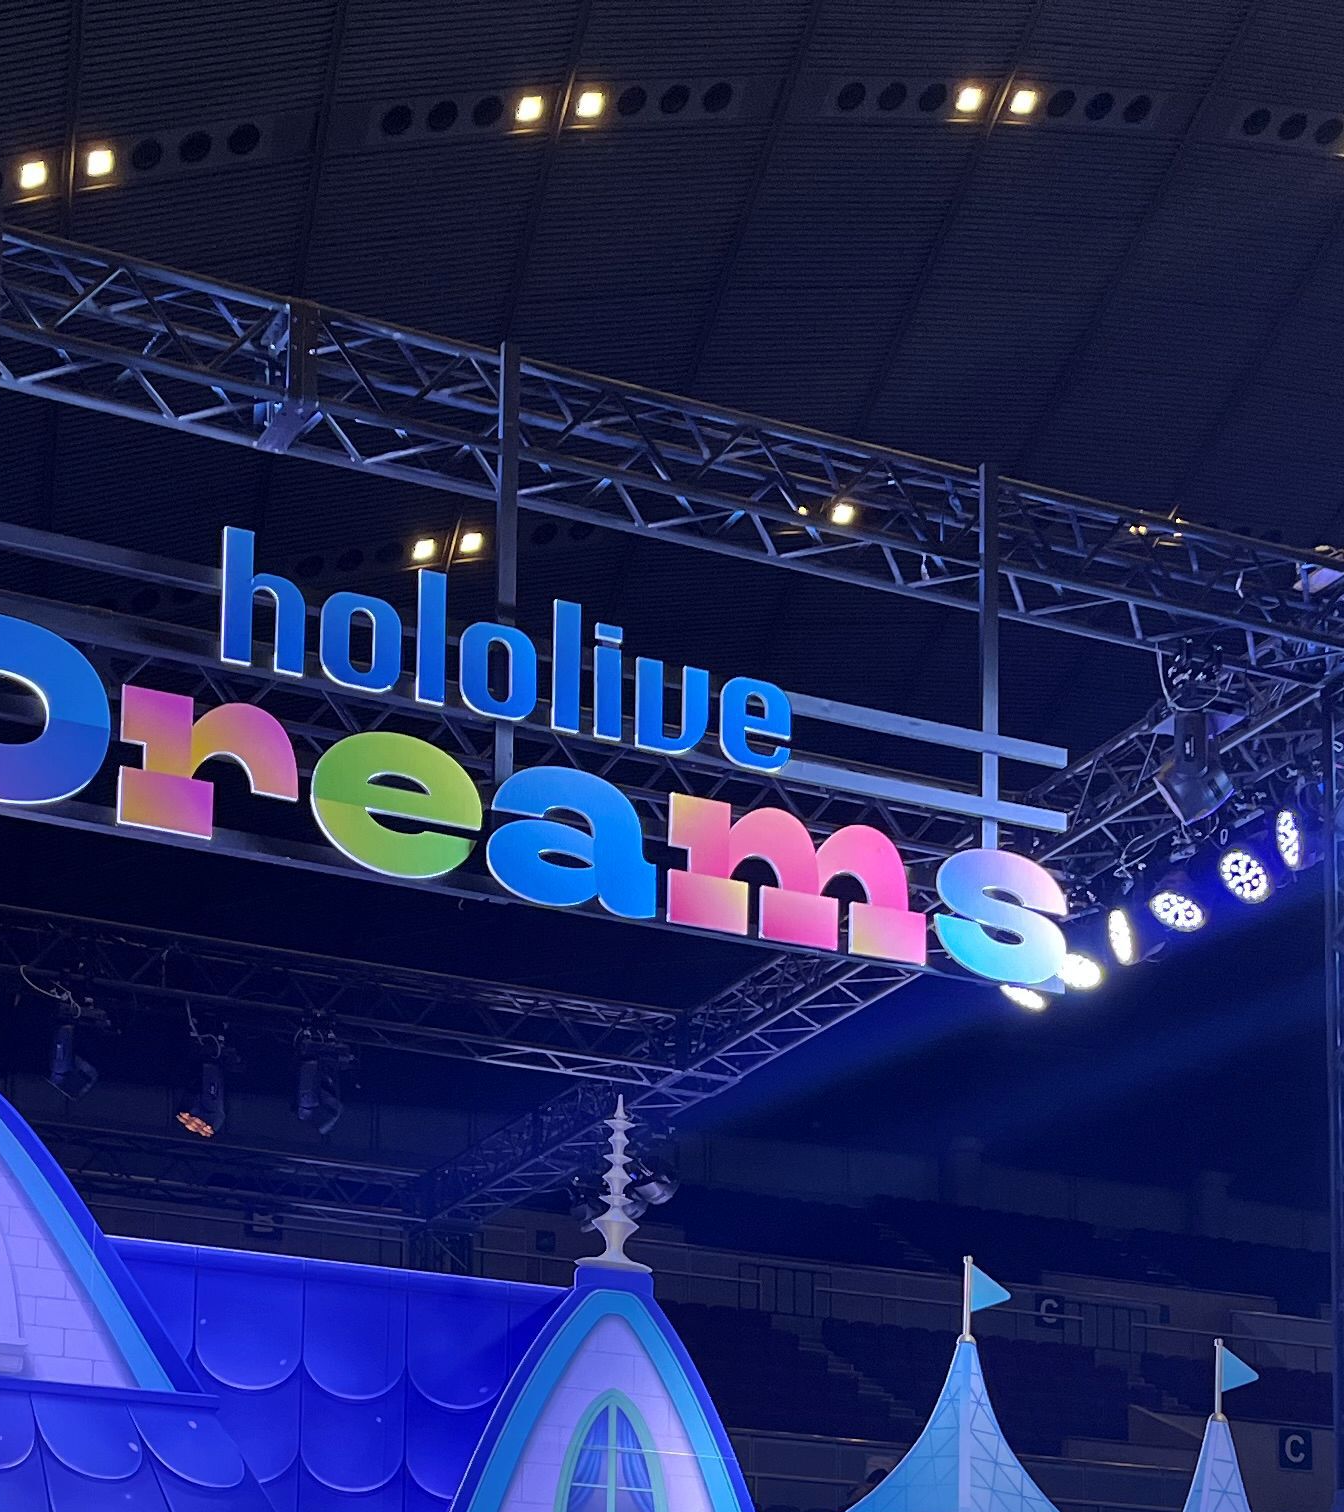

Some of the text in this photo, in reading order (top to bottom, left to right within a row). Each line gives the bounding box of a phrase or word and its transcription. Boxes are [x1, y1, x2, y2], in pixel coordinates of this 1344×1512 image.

[220, 525, 792, 772] hololive
[1040, 1299, 1058, 1323] C
[1285, 1435, 1305, 1463] C
